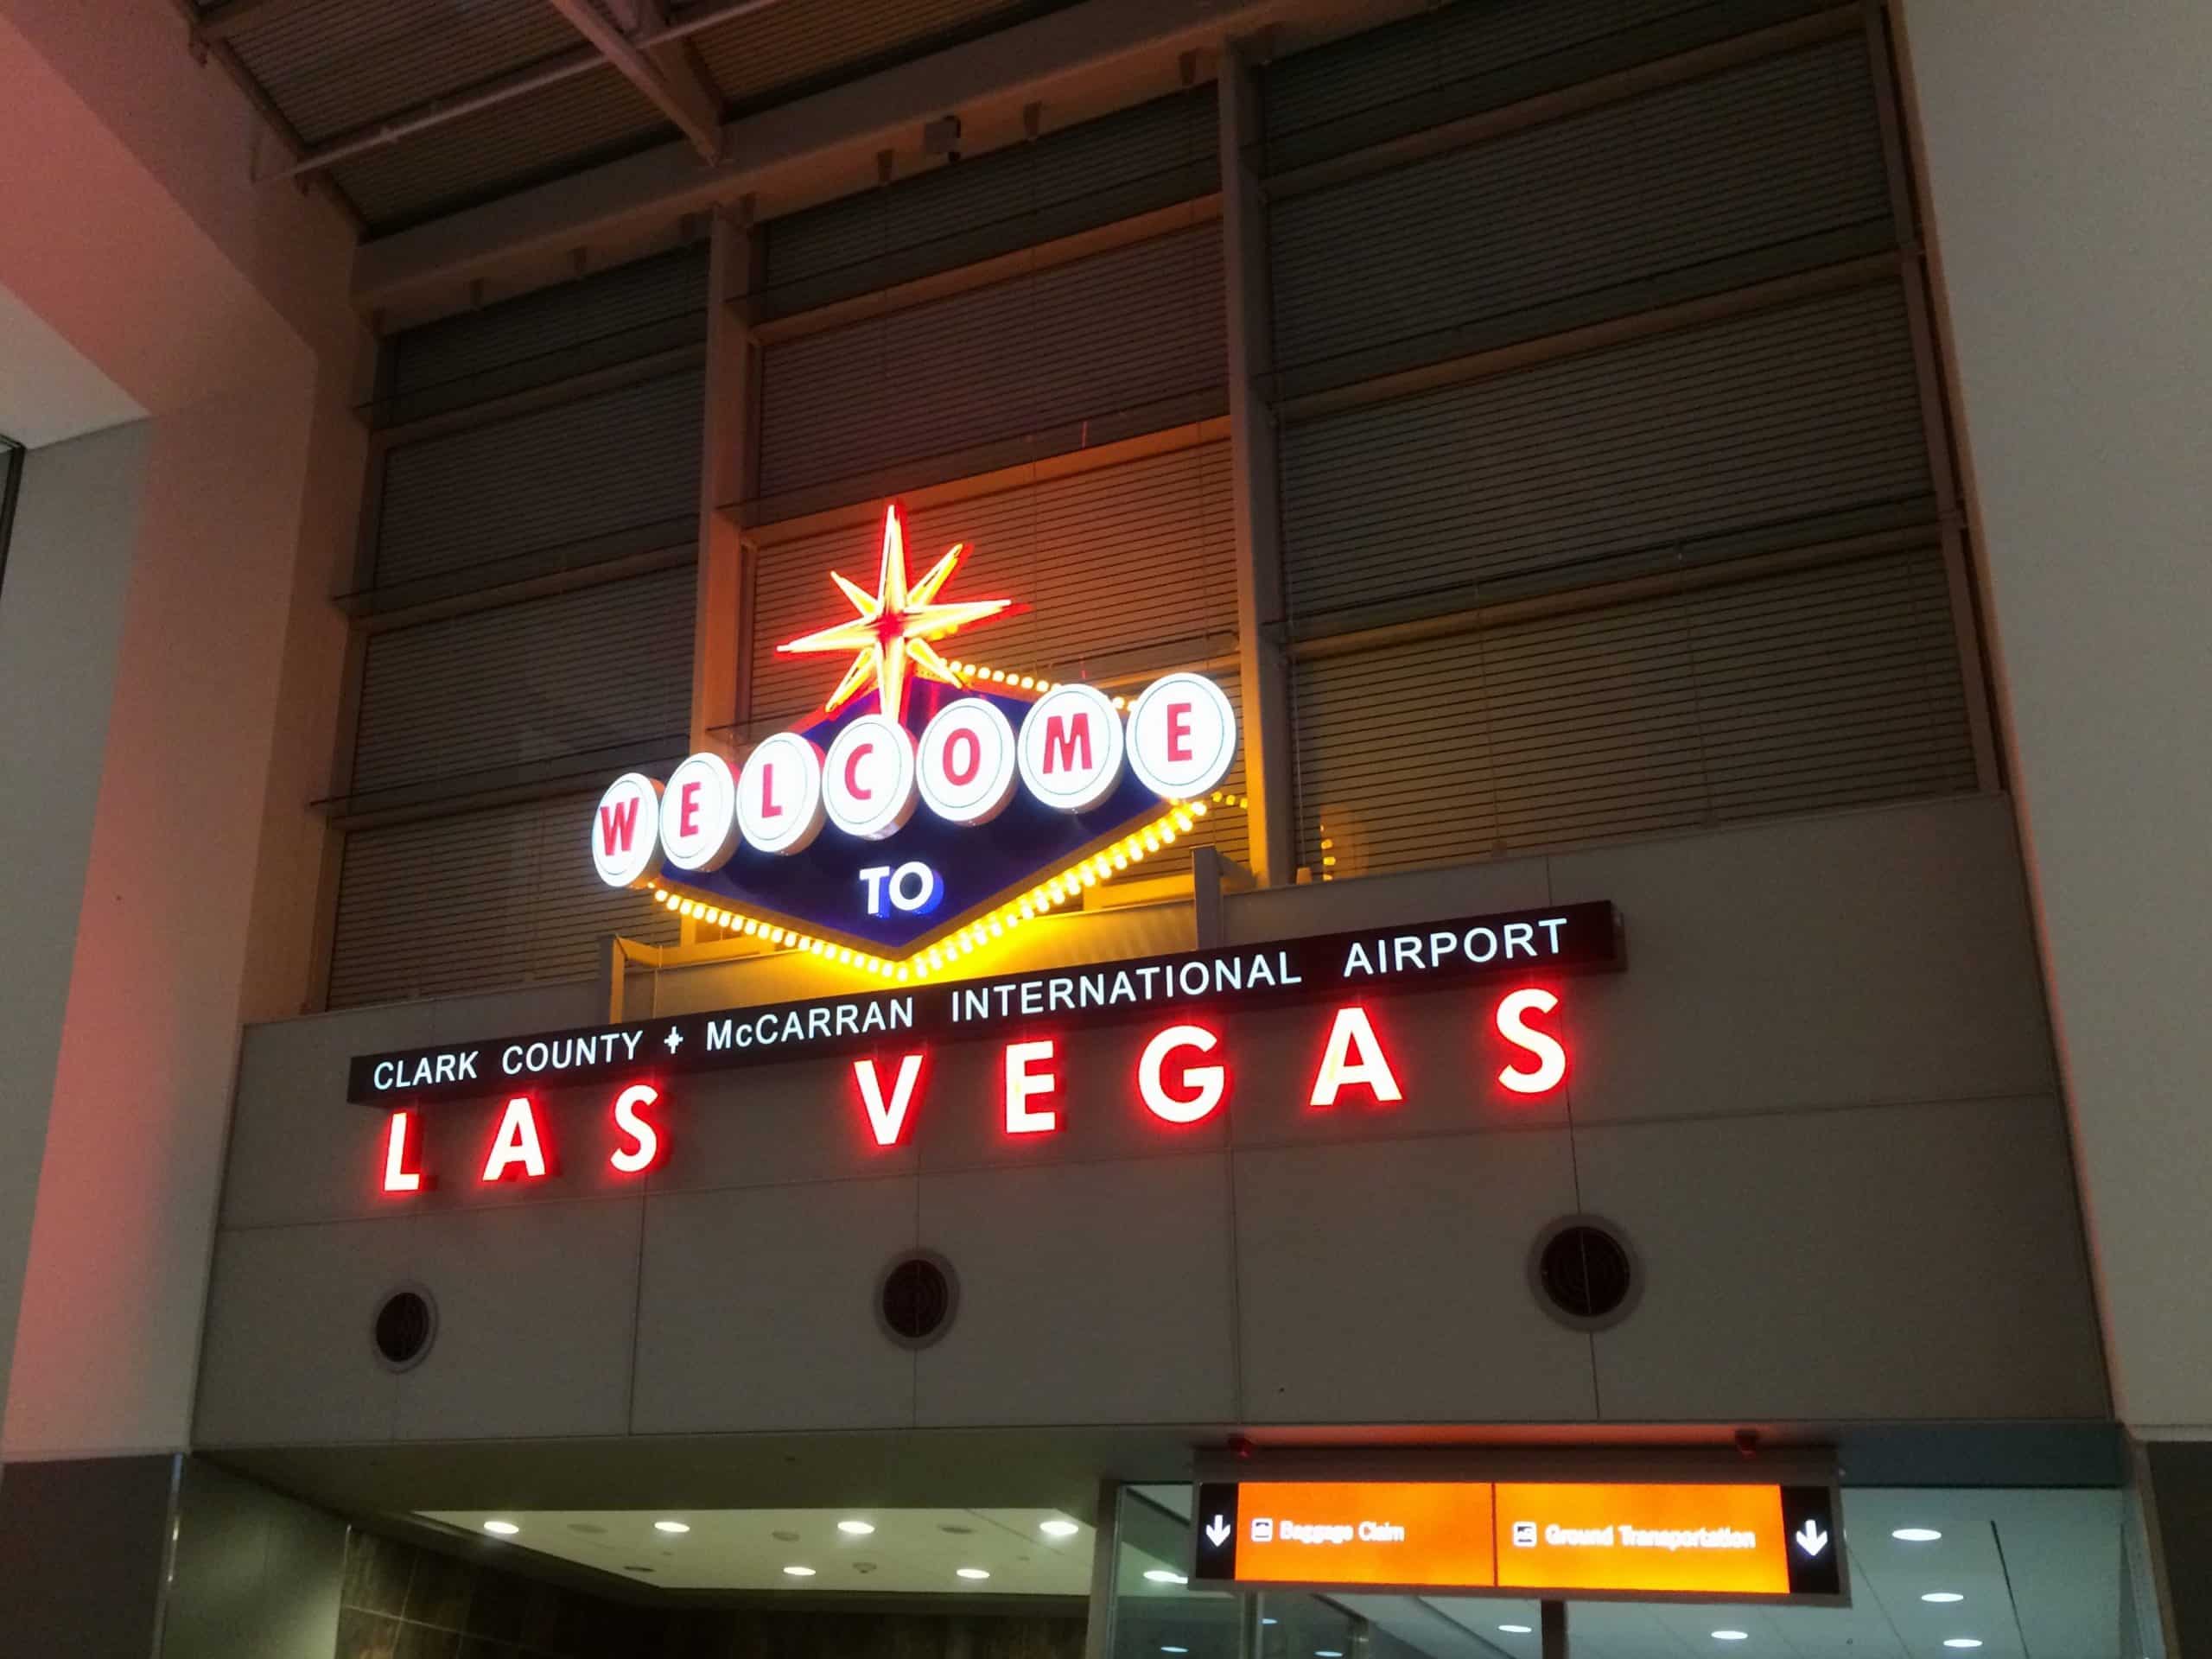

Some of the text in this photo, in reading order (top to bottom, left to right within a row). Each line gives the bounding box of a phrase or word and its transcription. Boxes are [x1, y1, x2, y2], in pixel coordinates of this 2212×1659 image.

[600, 702, 1193, 857] WELCOME
[860, 861, 936, 914] TO
[373, 918, 1568, 1090] CLARK COUNTY McCARRAN INTERNATIONAL AIRPORT
[383, 988, 1567, 1192] LAS VEGAS
[1280, 1521, 1406, 1543] Baggage Claim
[1545, 1525, 1757, 1552] Ground Transportation
